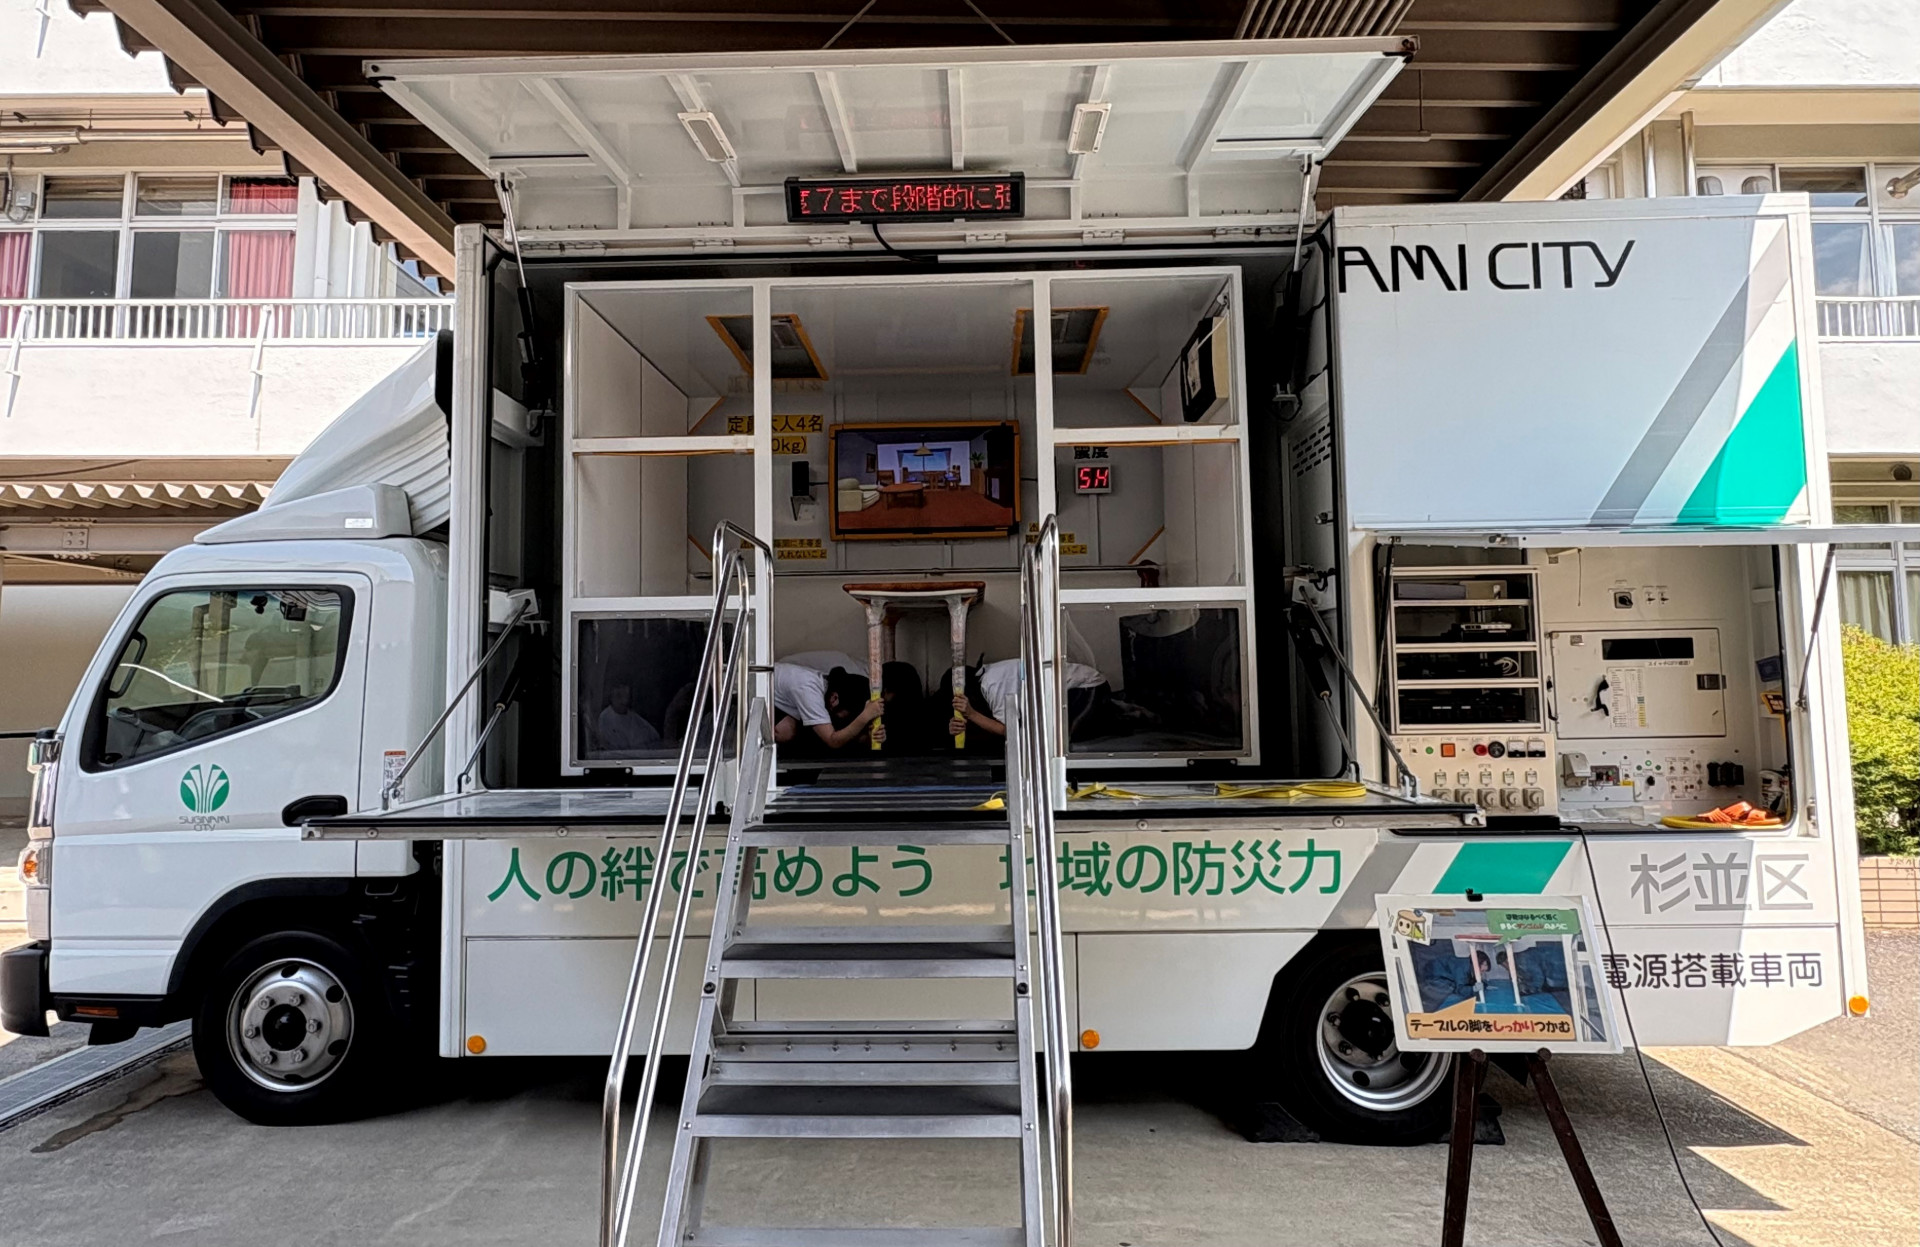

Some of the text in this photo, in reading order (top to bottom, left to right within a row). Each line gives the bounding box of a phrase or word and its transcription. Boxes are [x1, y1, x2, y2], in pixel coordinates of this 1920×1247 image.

[1337, 240, 1636, 293] AMI CITY
[178, 815, 230, 825] SUGINAMI
[193, 823, 216, 832] CITY
[1629, 852, 1814, 914] 杉並区
[1601, 952, 1823, 989] 電源搭載車両
[1409, 1019, 1571, 1034] テーブルの脚をしっかりつかむ
